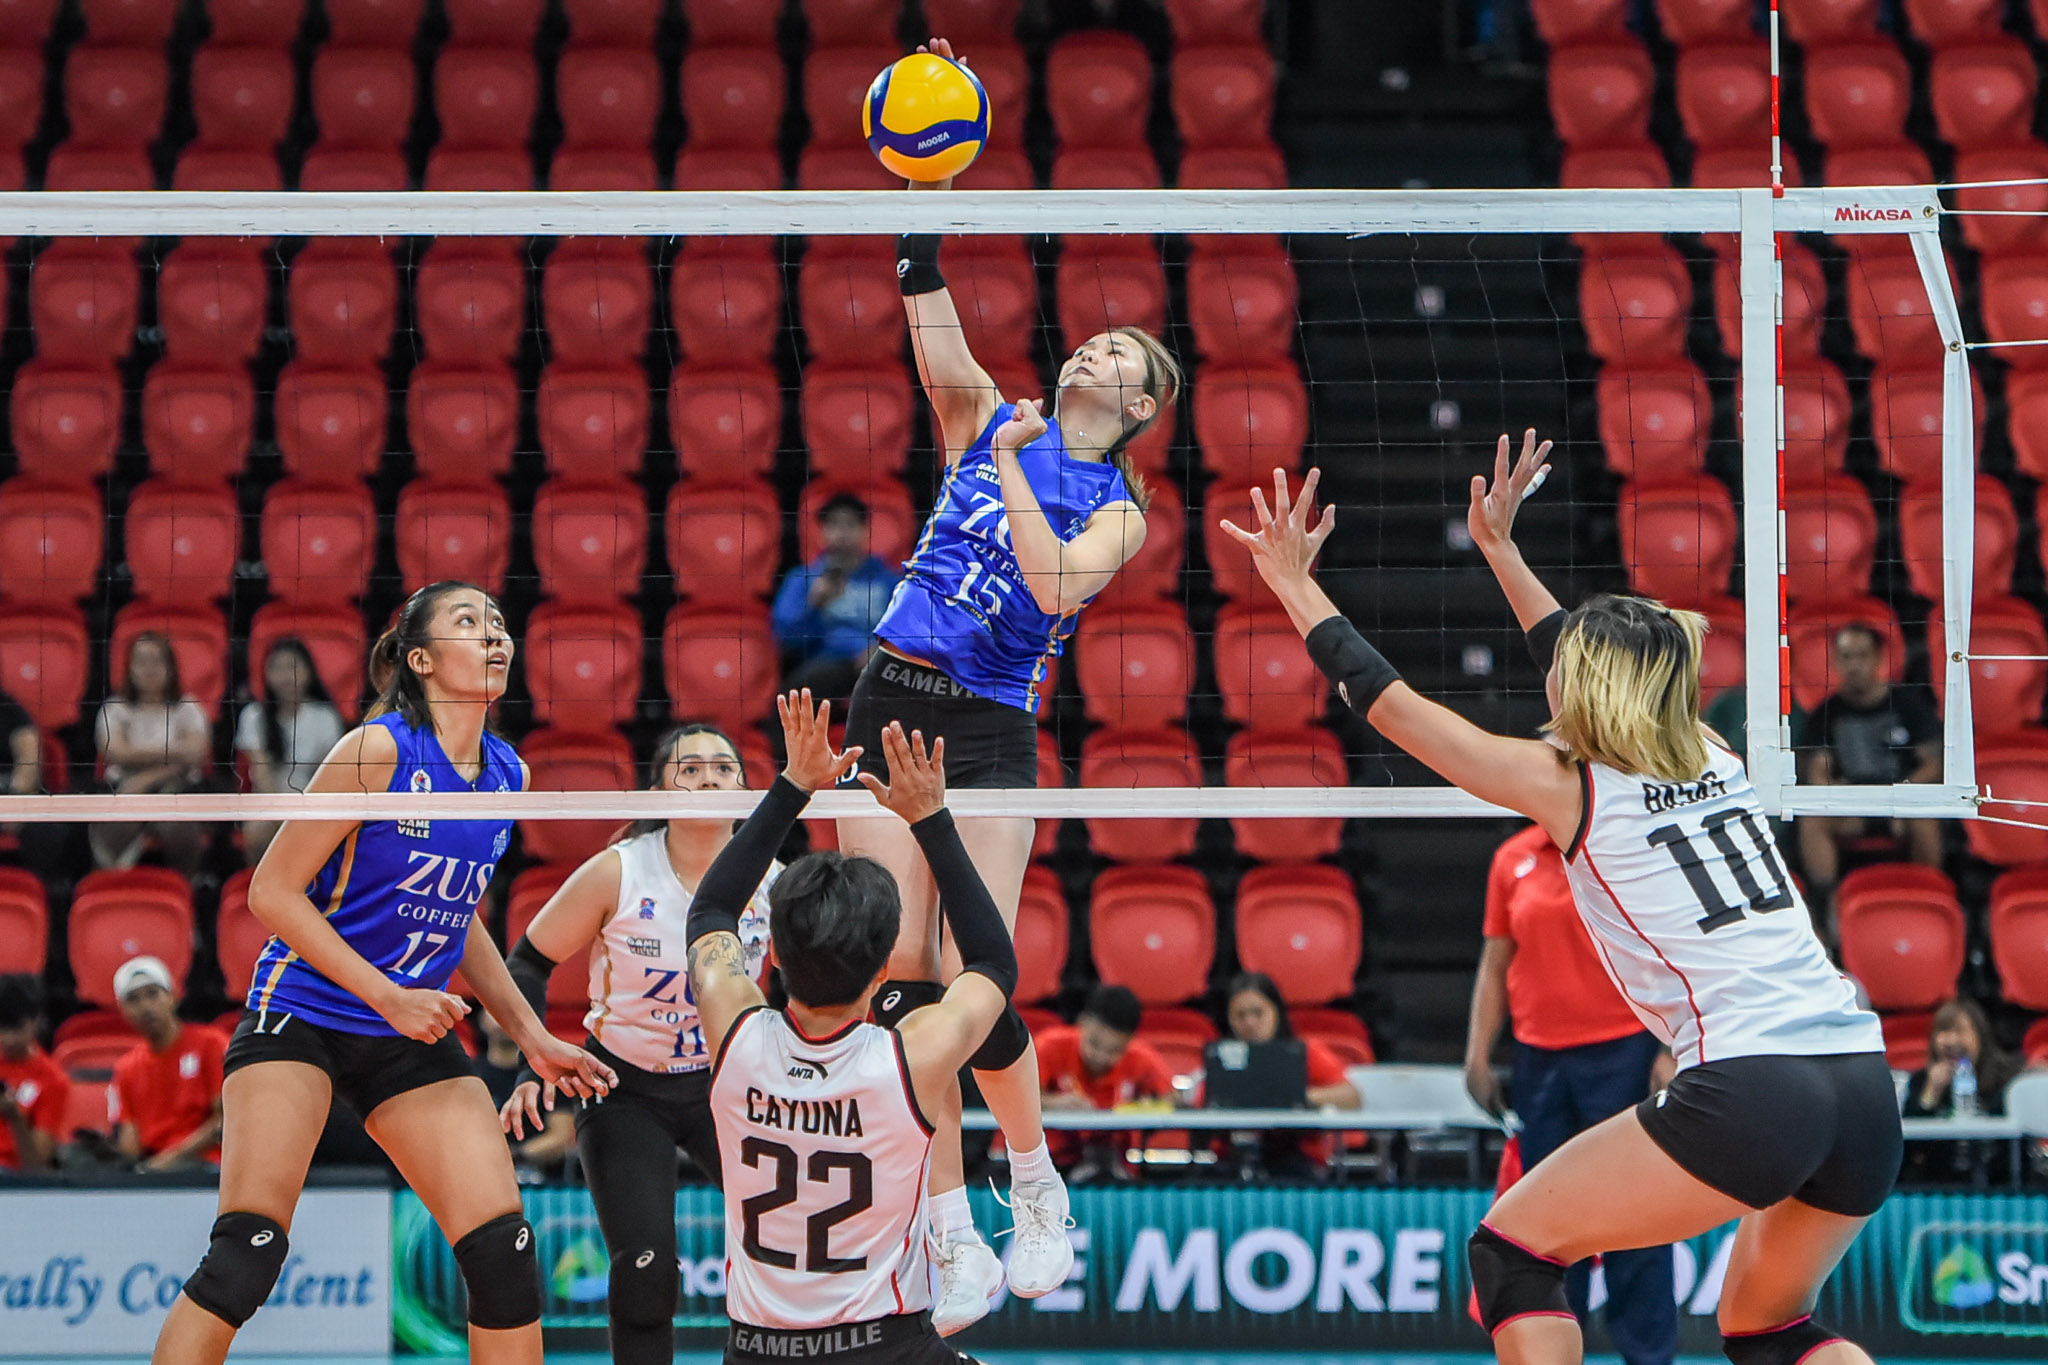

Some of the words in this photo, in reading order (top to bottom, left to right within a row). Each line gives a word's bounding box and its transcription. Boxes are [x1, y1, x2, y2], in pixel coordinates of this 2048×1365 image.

[917, 131, 950, 151] V200W
[953, 562, 1012, 616] 15
[881, 662, 981, 699] GAMEV
[397, 825, 430, 839] VILLE
[396, 850, 495, 905] ZUS
[1645, 807, 1795, 935] 10
[397, 903, 470, 928] COFFEE
[386, 931, 450, 980] 17
[669, 1024, 707, 1058] 11
[787, 1067, 814, 1080] ANTA
[746, 1086, 863, 1138] CAYUNA
[741, 1135, 873, 1274] 22
[1115, 1227, 1445, 1313] MORE
[735, 1321, 882, 1358] GAMEVILLE
